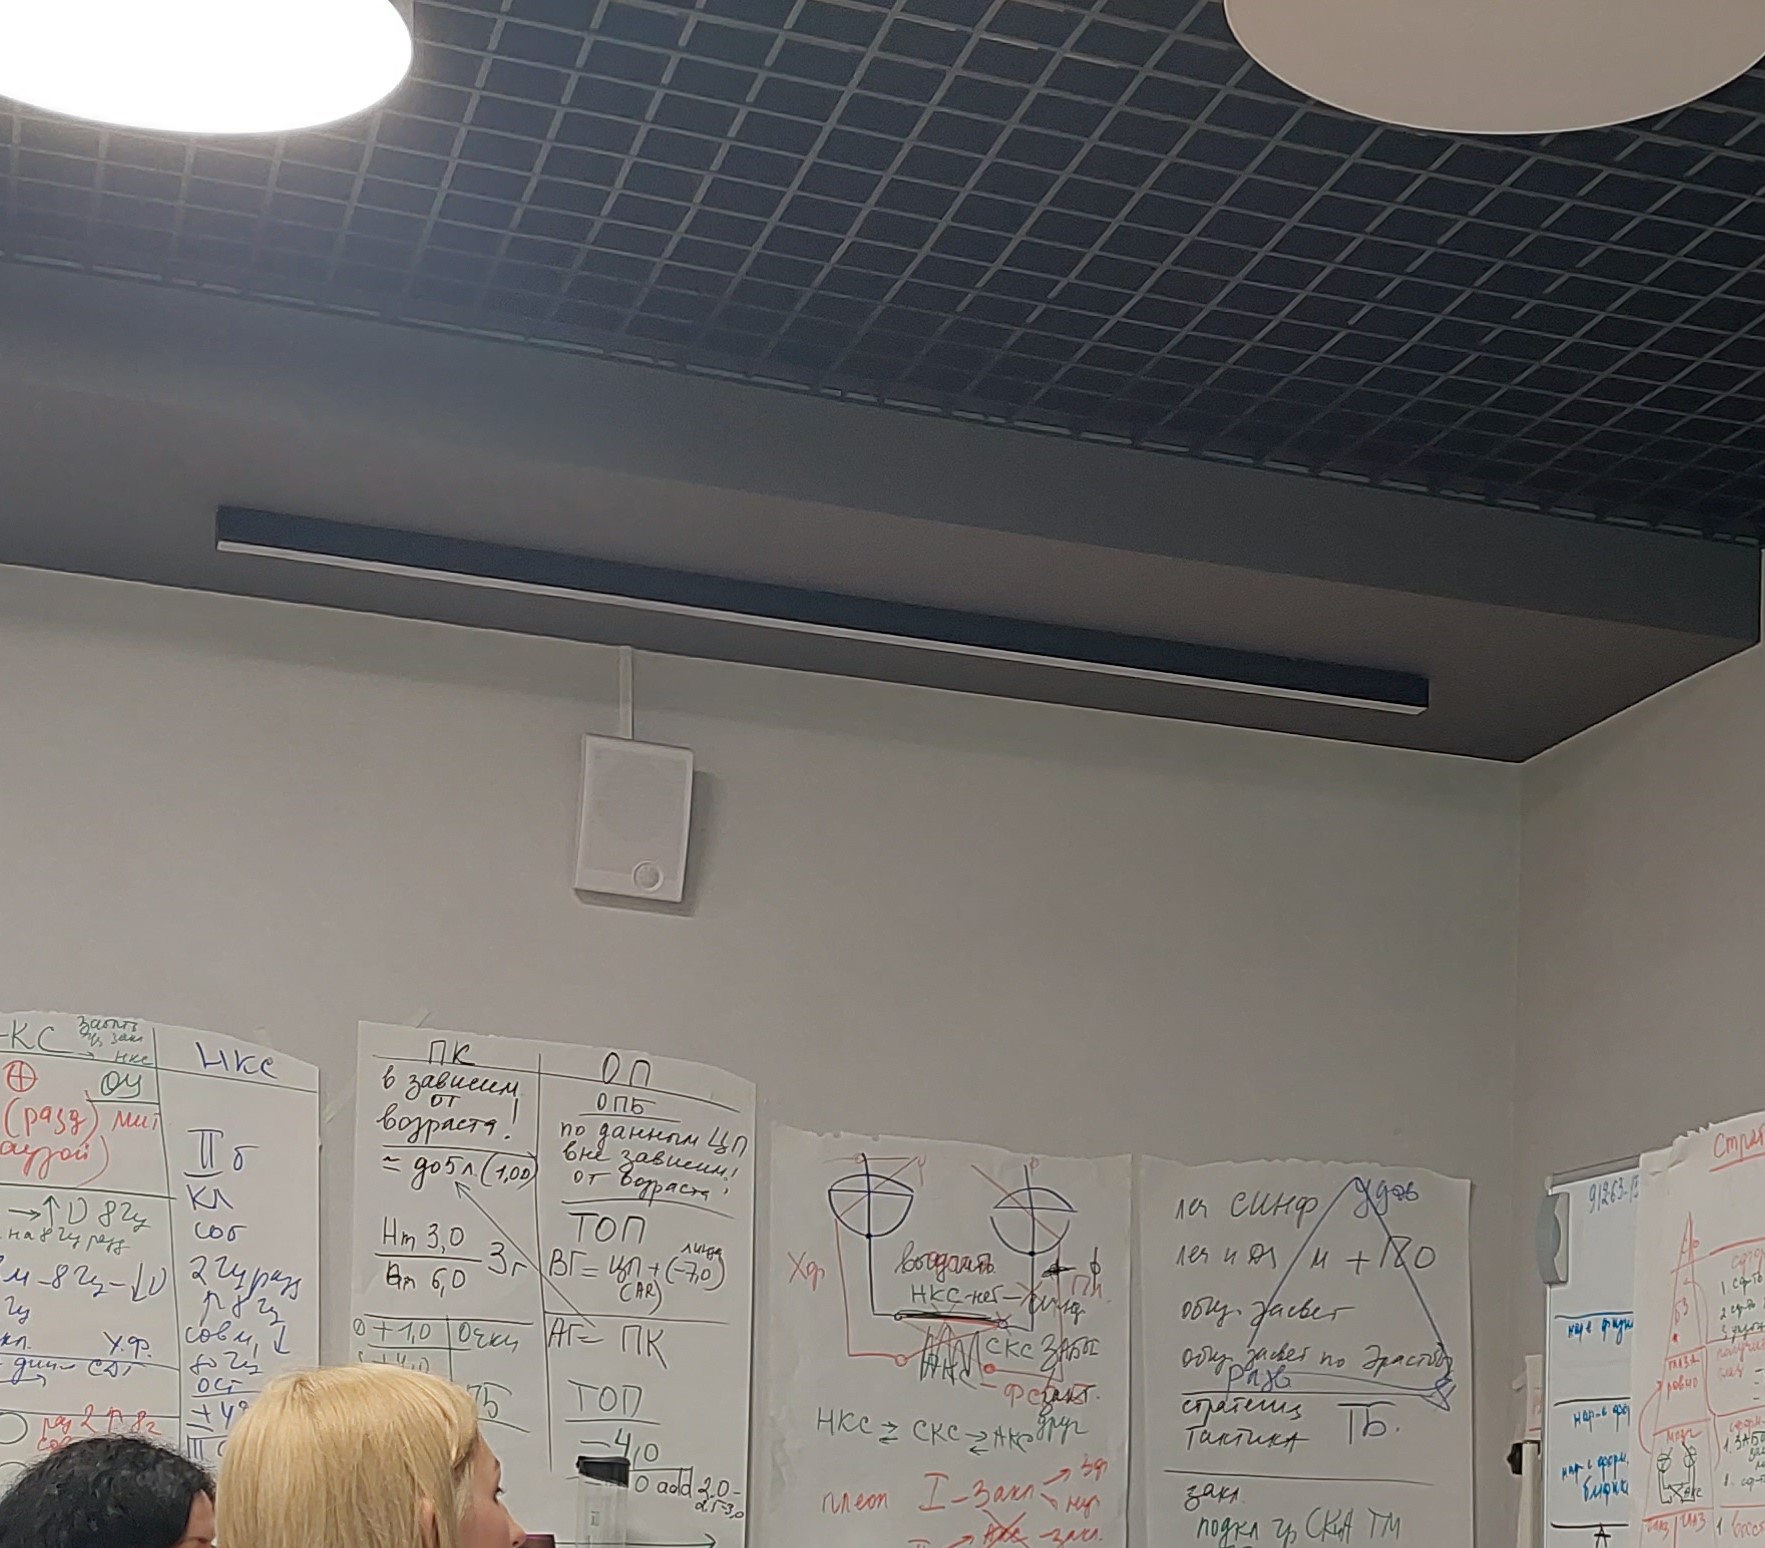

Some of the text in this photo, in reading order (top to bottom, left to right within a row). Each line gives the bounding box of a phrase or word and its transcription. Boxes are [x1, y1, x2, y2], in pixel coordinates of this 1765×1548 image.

[428, 1040, 476, 1067] ПК
[601, 1052, 652, 1088] ОП
[560, 1120, 586, 1138] по
[566, 1211, 646, 1244] ТОП
[622, 1325, 669, 1370] ПК
[566, 1379, 643, 1419] ТОП
